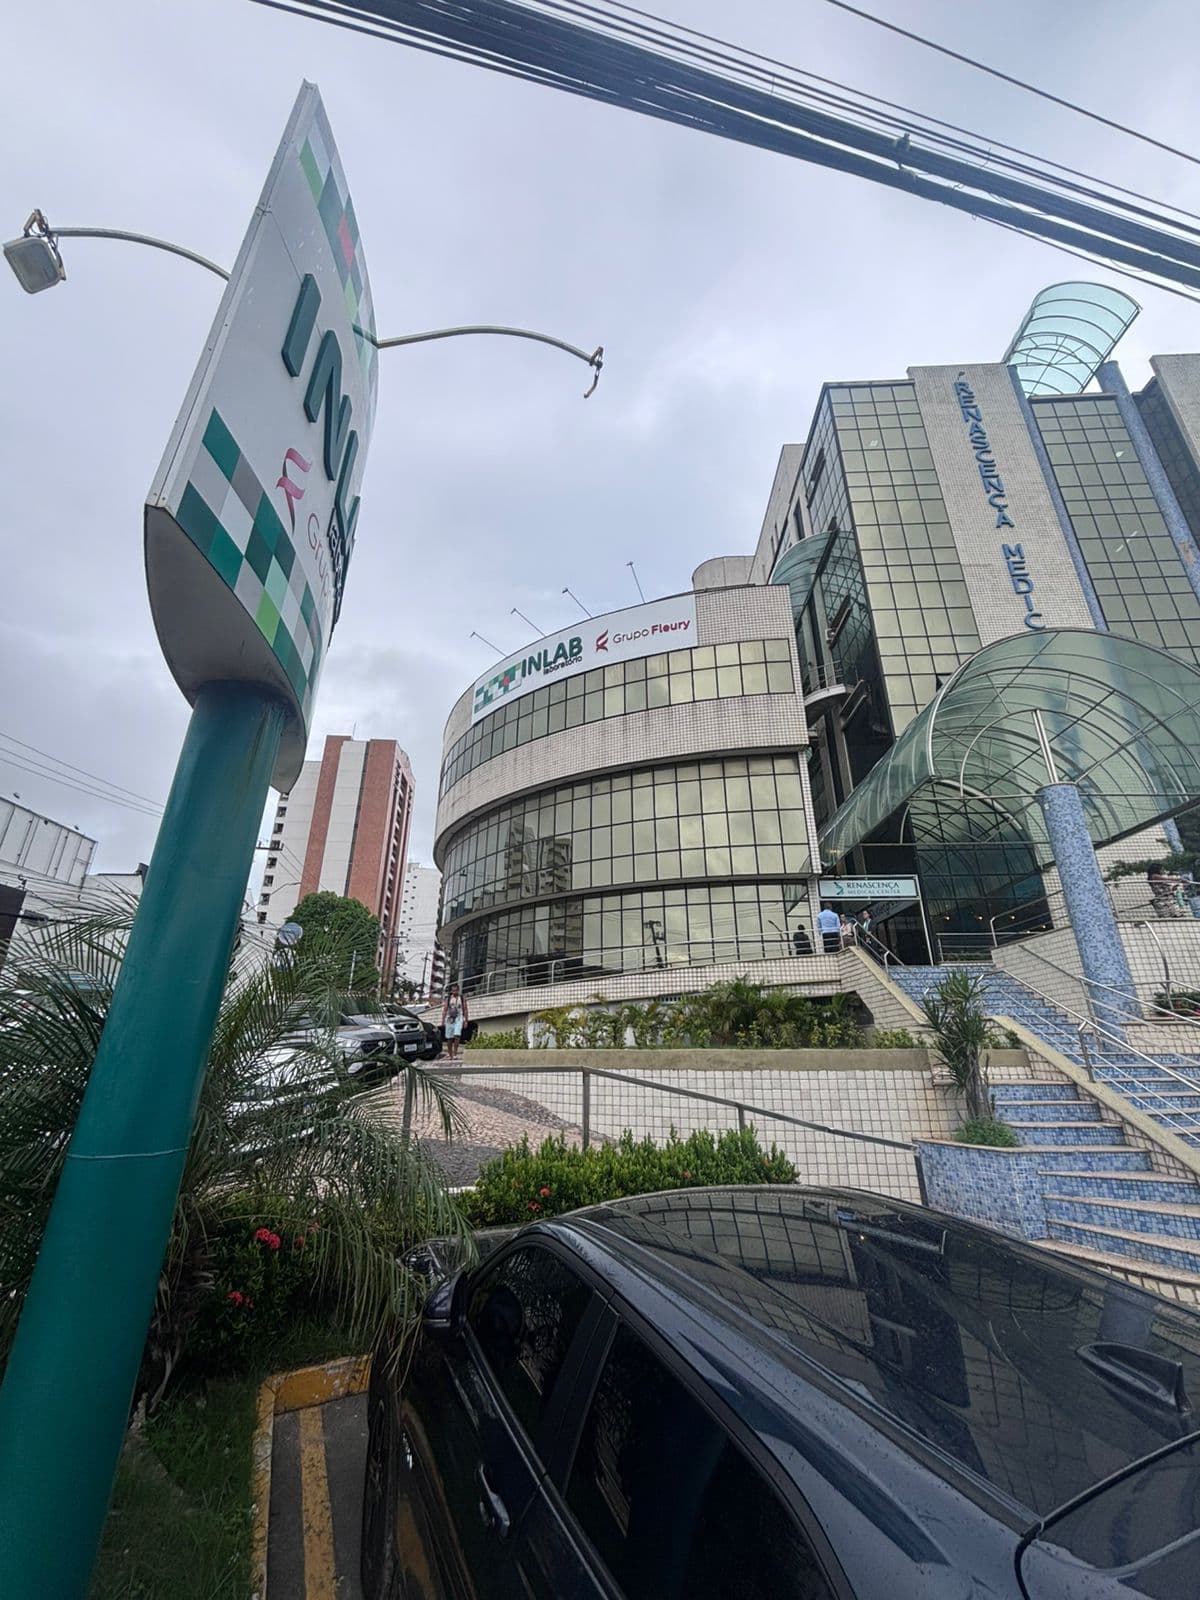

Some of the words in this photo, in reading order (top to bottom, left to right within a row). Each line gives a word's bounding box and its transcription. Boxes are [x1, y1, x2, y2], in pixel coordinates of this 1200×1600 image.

[954, 381, 1015, 529] RENASCENÇA
[308, 512, 331, 600] Grup
[612, 627, 650, 645] Grupo
[651, 619, 691, 636] Fleury
[521, 636, 583, 678] INLAB
[846, 881, 900, 890] RENASCENÇA
